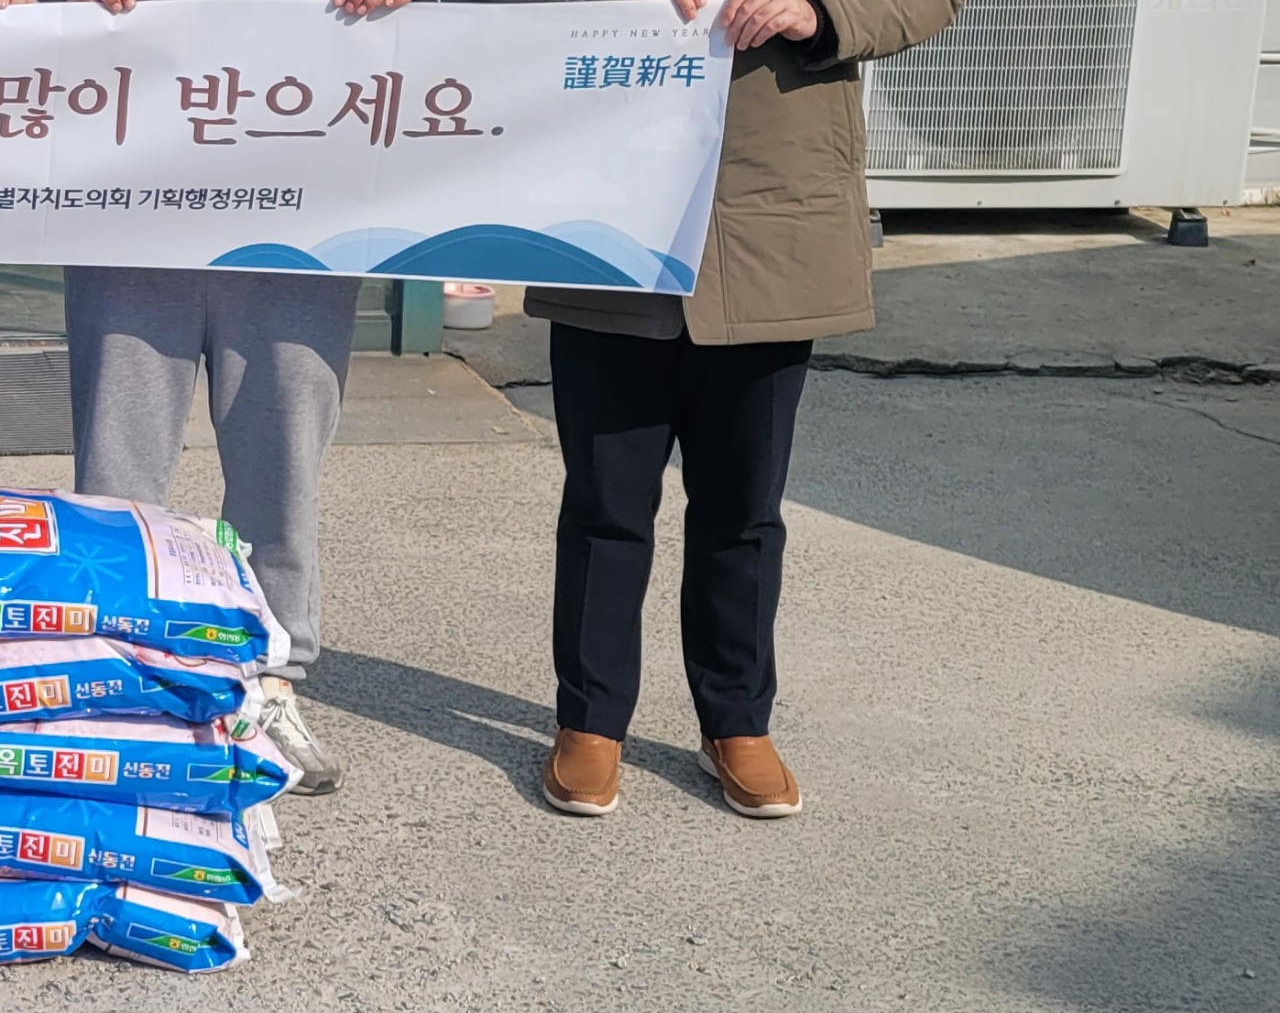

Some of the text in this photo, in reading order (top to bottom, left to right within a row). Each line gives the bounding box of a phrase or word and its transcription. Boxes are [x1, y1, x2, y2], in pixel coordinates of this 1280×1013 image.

[570, 27, 710, 38] HAPPY NEW YEAR
[563, 53, 706, 90] 謹賀新年
[175, 66, 504, 149] 받으세요.
[137, 187, 304, 211] 기획행정위원회
[101, 615, 150, 636] 신동진
[74, 679, 124, 700] 신동진
[122, 761, 171, 780] 신동진
[88, 848, 136, 872] 신동진
